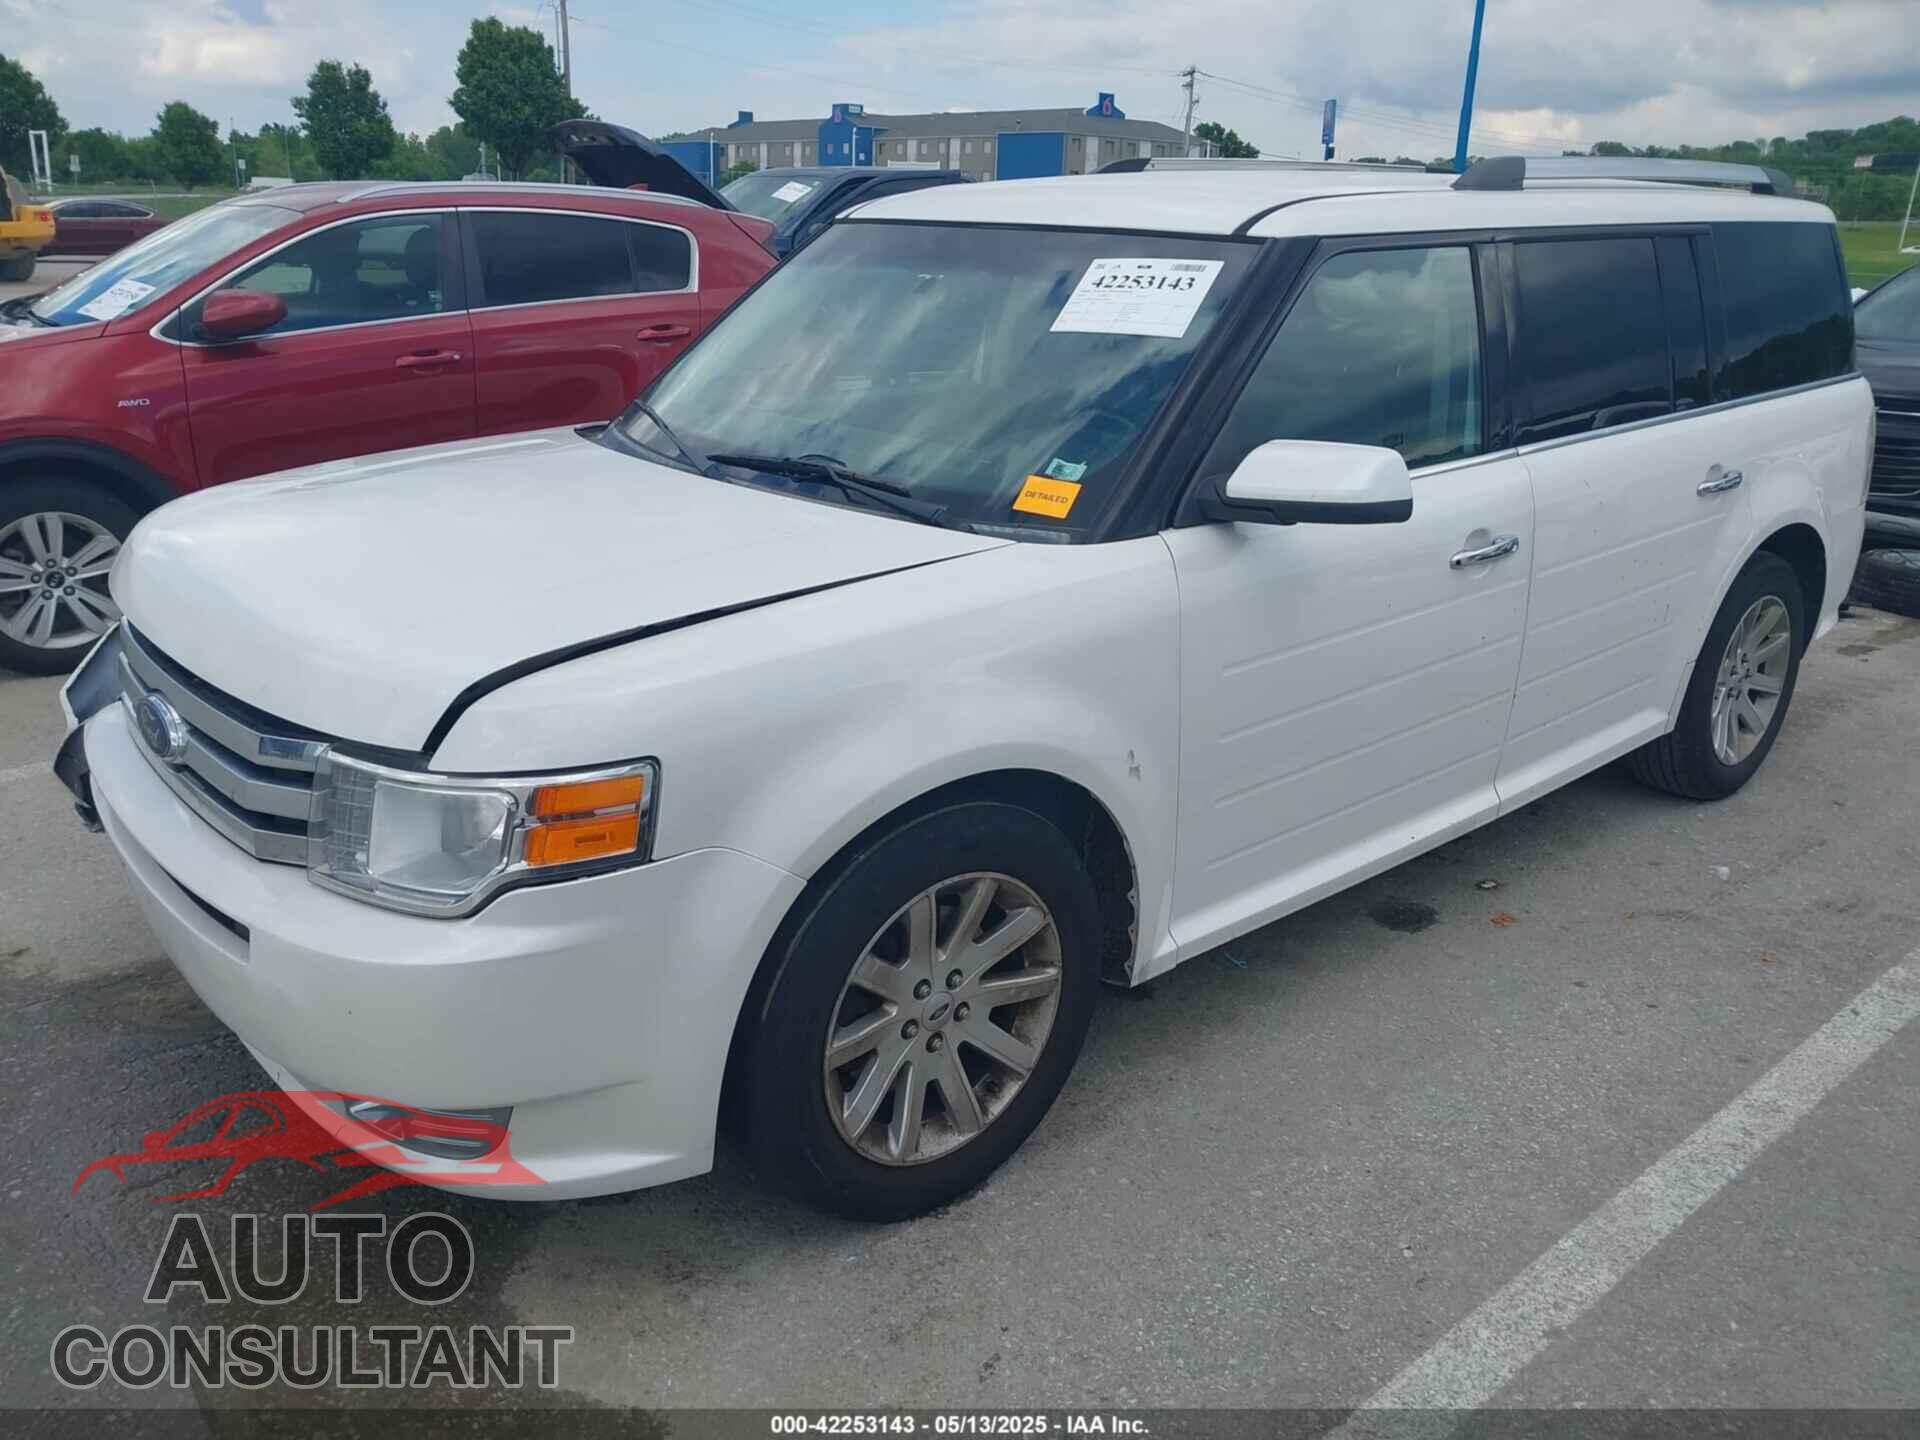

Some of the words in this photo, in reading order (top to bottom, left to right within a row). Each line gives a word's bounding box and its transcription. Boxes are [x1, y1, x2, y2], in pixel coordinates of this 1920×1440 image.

[1092, 275, 1196, 291] 42253143
[117, 398, 151, 408] AWD
[1024, 490, 1069, 504] DETAILED
